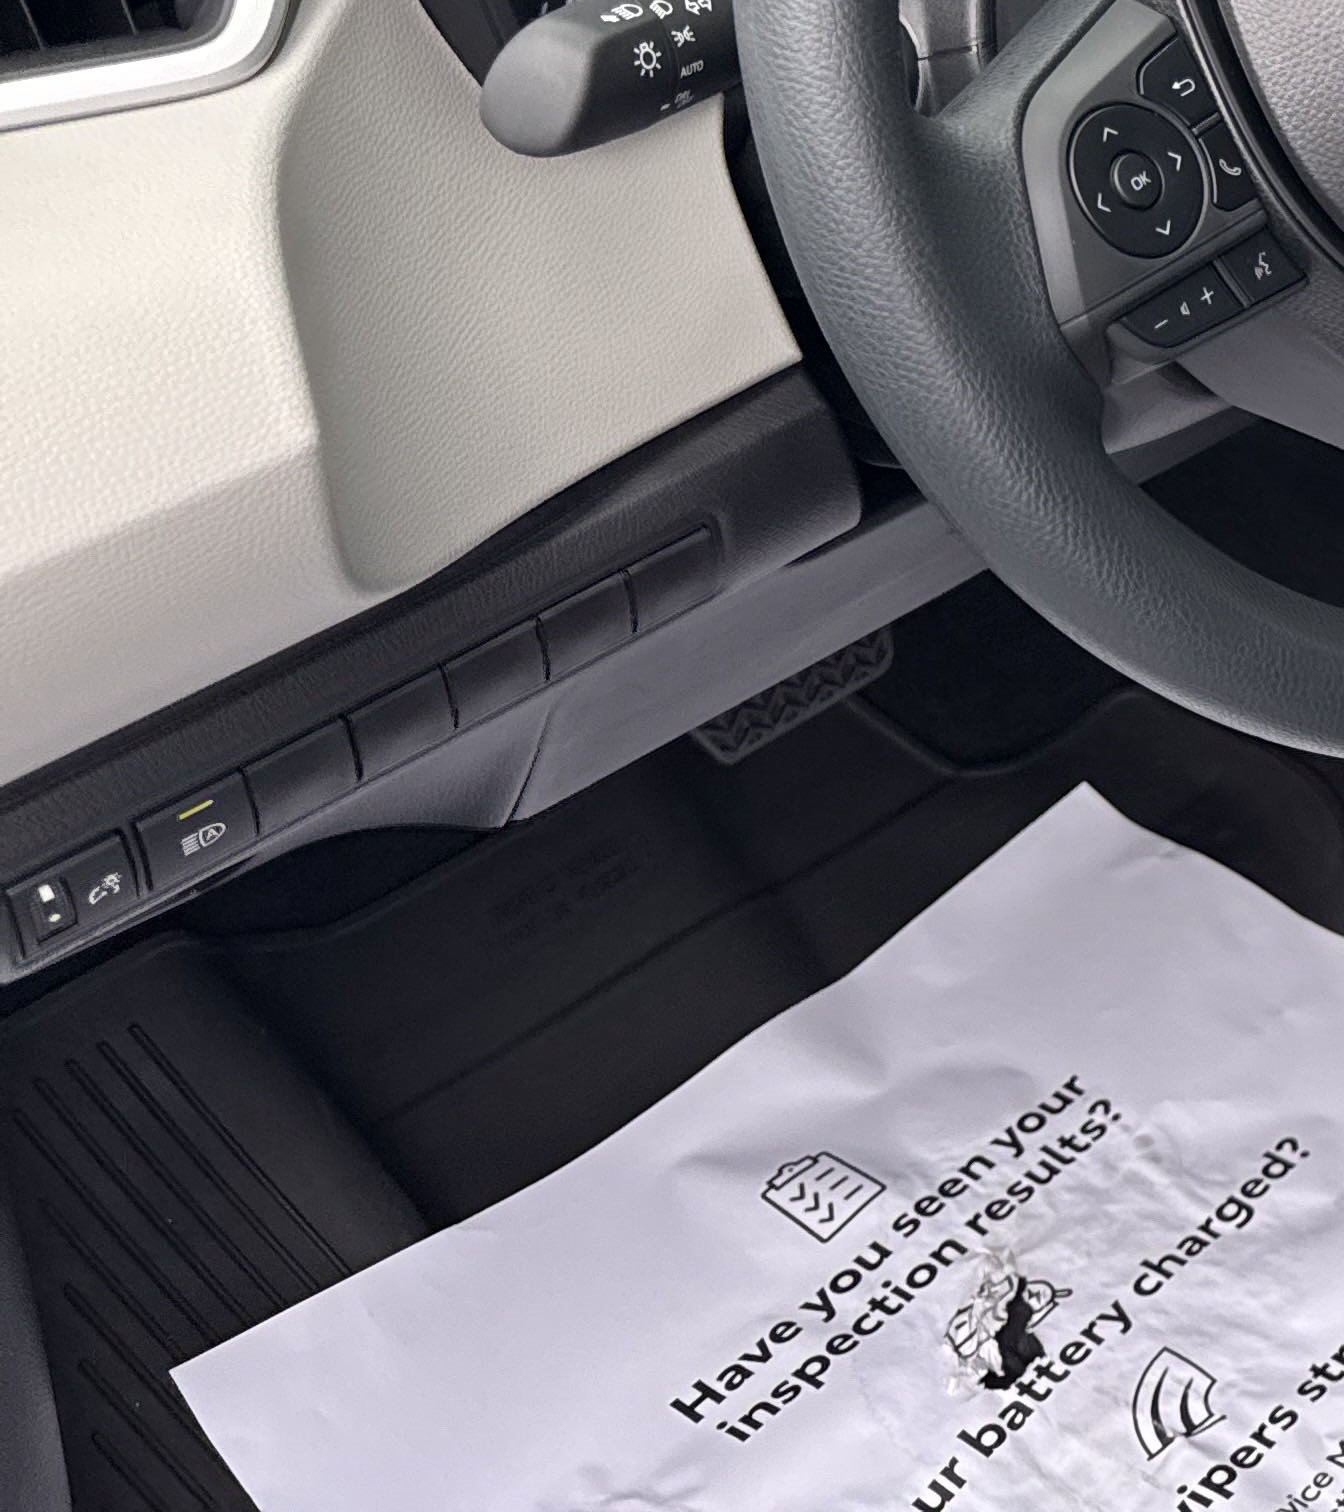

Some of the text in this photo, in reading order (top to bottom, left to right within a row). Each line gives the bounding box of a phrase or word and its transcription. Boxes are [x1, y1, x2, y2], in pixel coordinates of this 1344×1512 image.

[680, 60, 704, 79] AUTO
[1130, 170, 1150, 191] OK
[669, 1075, 1085, 1424] Have you seen your
[716, 1099, 1121, 1442] inspection results?
[957, 1300, 1132, 1458] battery
[1133, 1136, 1310, 1297] charged?
